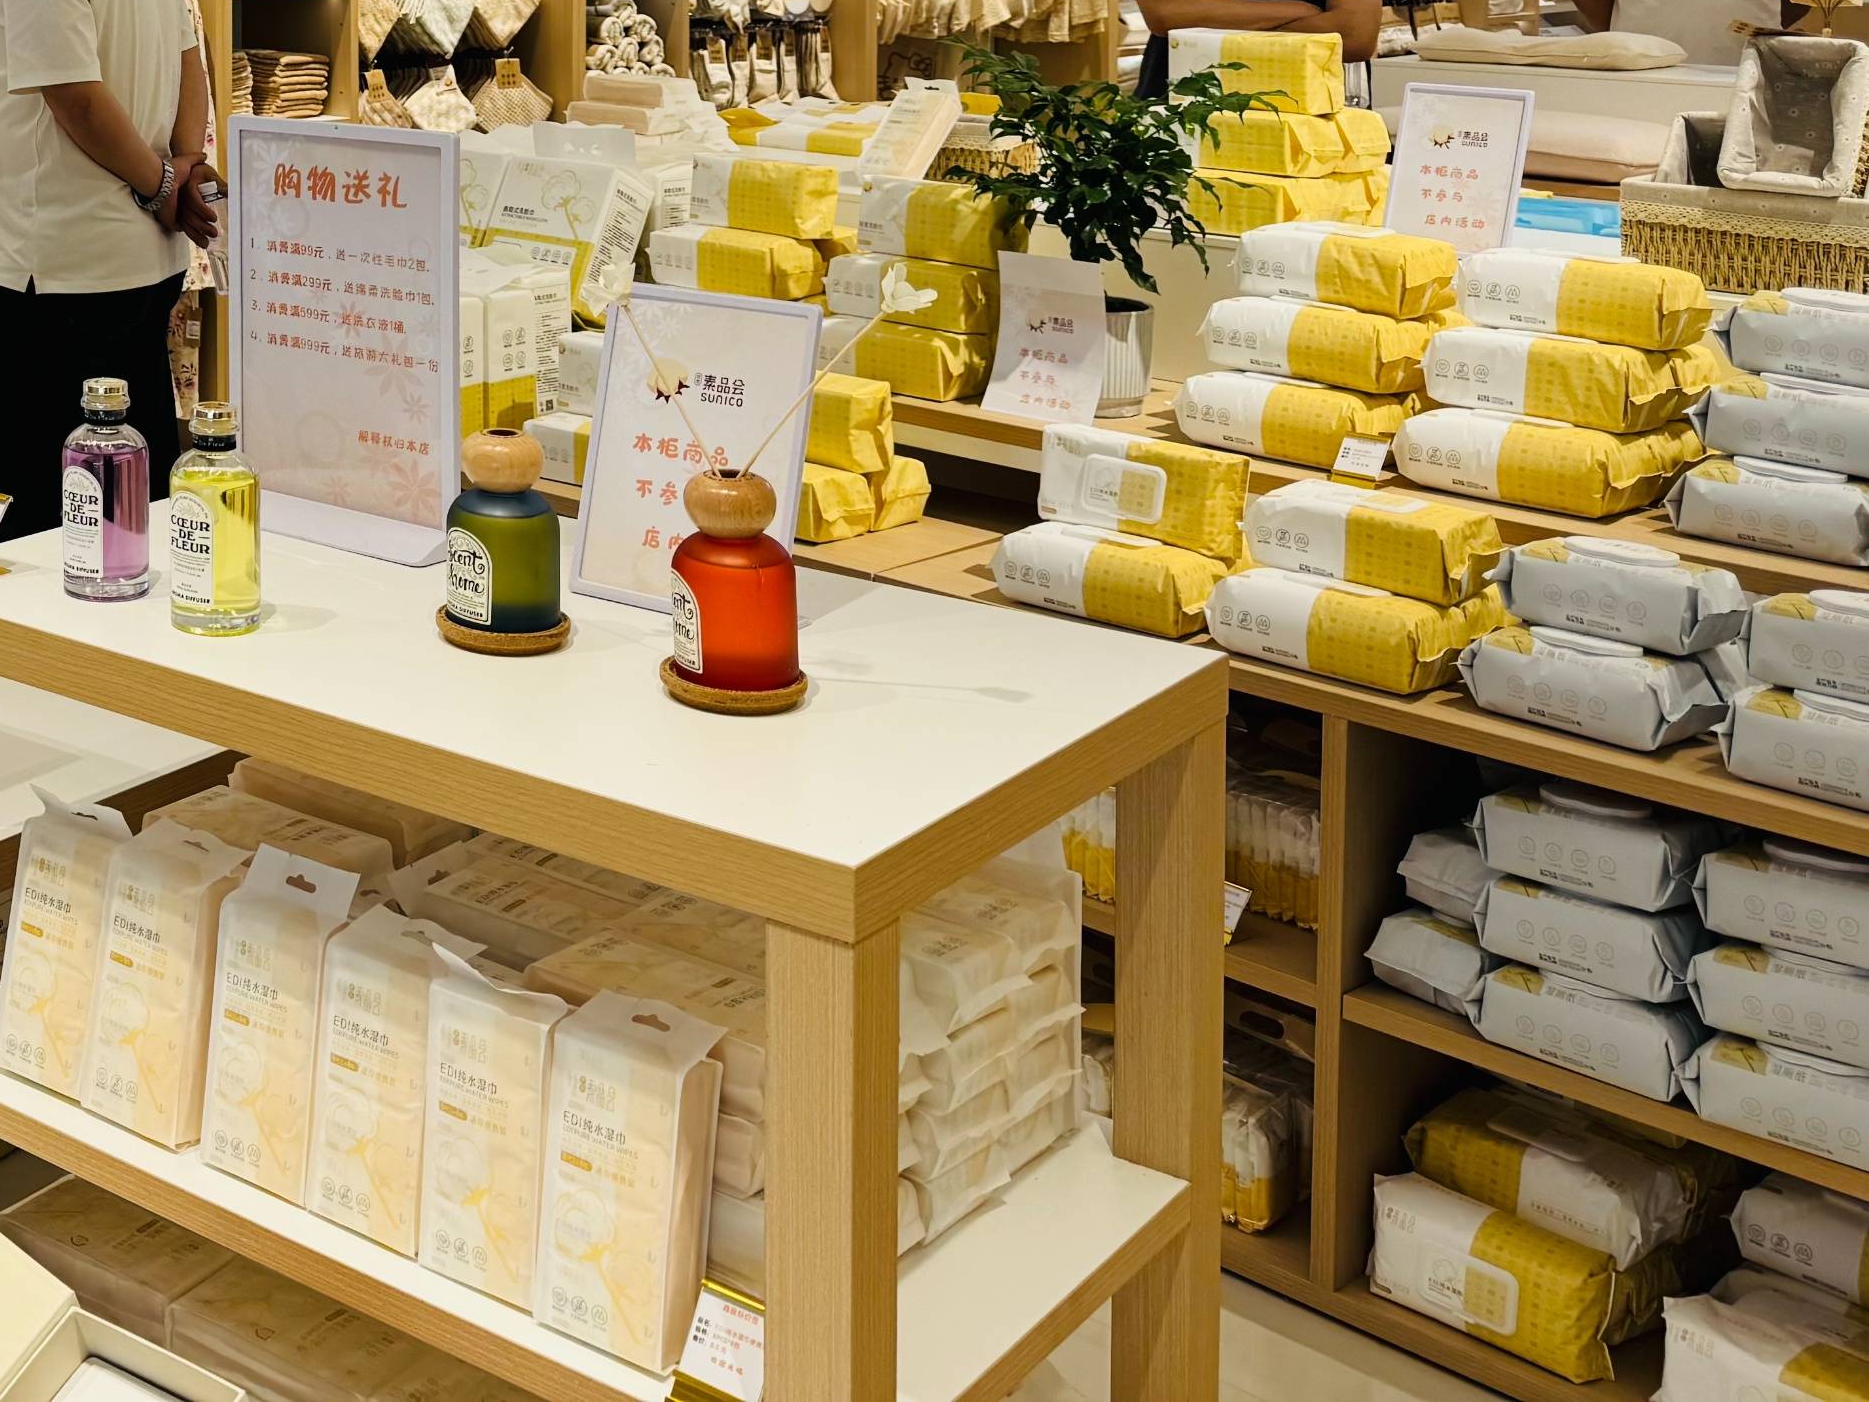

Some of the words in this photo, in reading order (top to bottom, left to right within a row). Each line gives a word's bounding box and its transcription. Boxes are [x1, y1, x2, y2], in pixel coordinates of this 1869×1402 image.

[274, 162, 408, 209] 购物送礼
[702, 374, 746, 396] 素品会
[358, 429, 430, 456] 解释权归本店
[63, 511, 99, 527] FLEUR
[69, 502, 86, 515] DE
[170, 536, 211, 555] FLEUR
[178, 529, 196, 542] DE
[25, 886, 72, 914] EDI纯水湿巾
[113, 915, 161, 944] EDI纯水湿巾
[226, 971, 279, 1001] EDI纯水湿巾
[332, 1014, 390, 1047] EDI纯水湿巾
[439, 1061, 498, 1096] EDI纯水湿巾
[562, 1109, 627, 1146] EDI纯水湿巾
